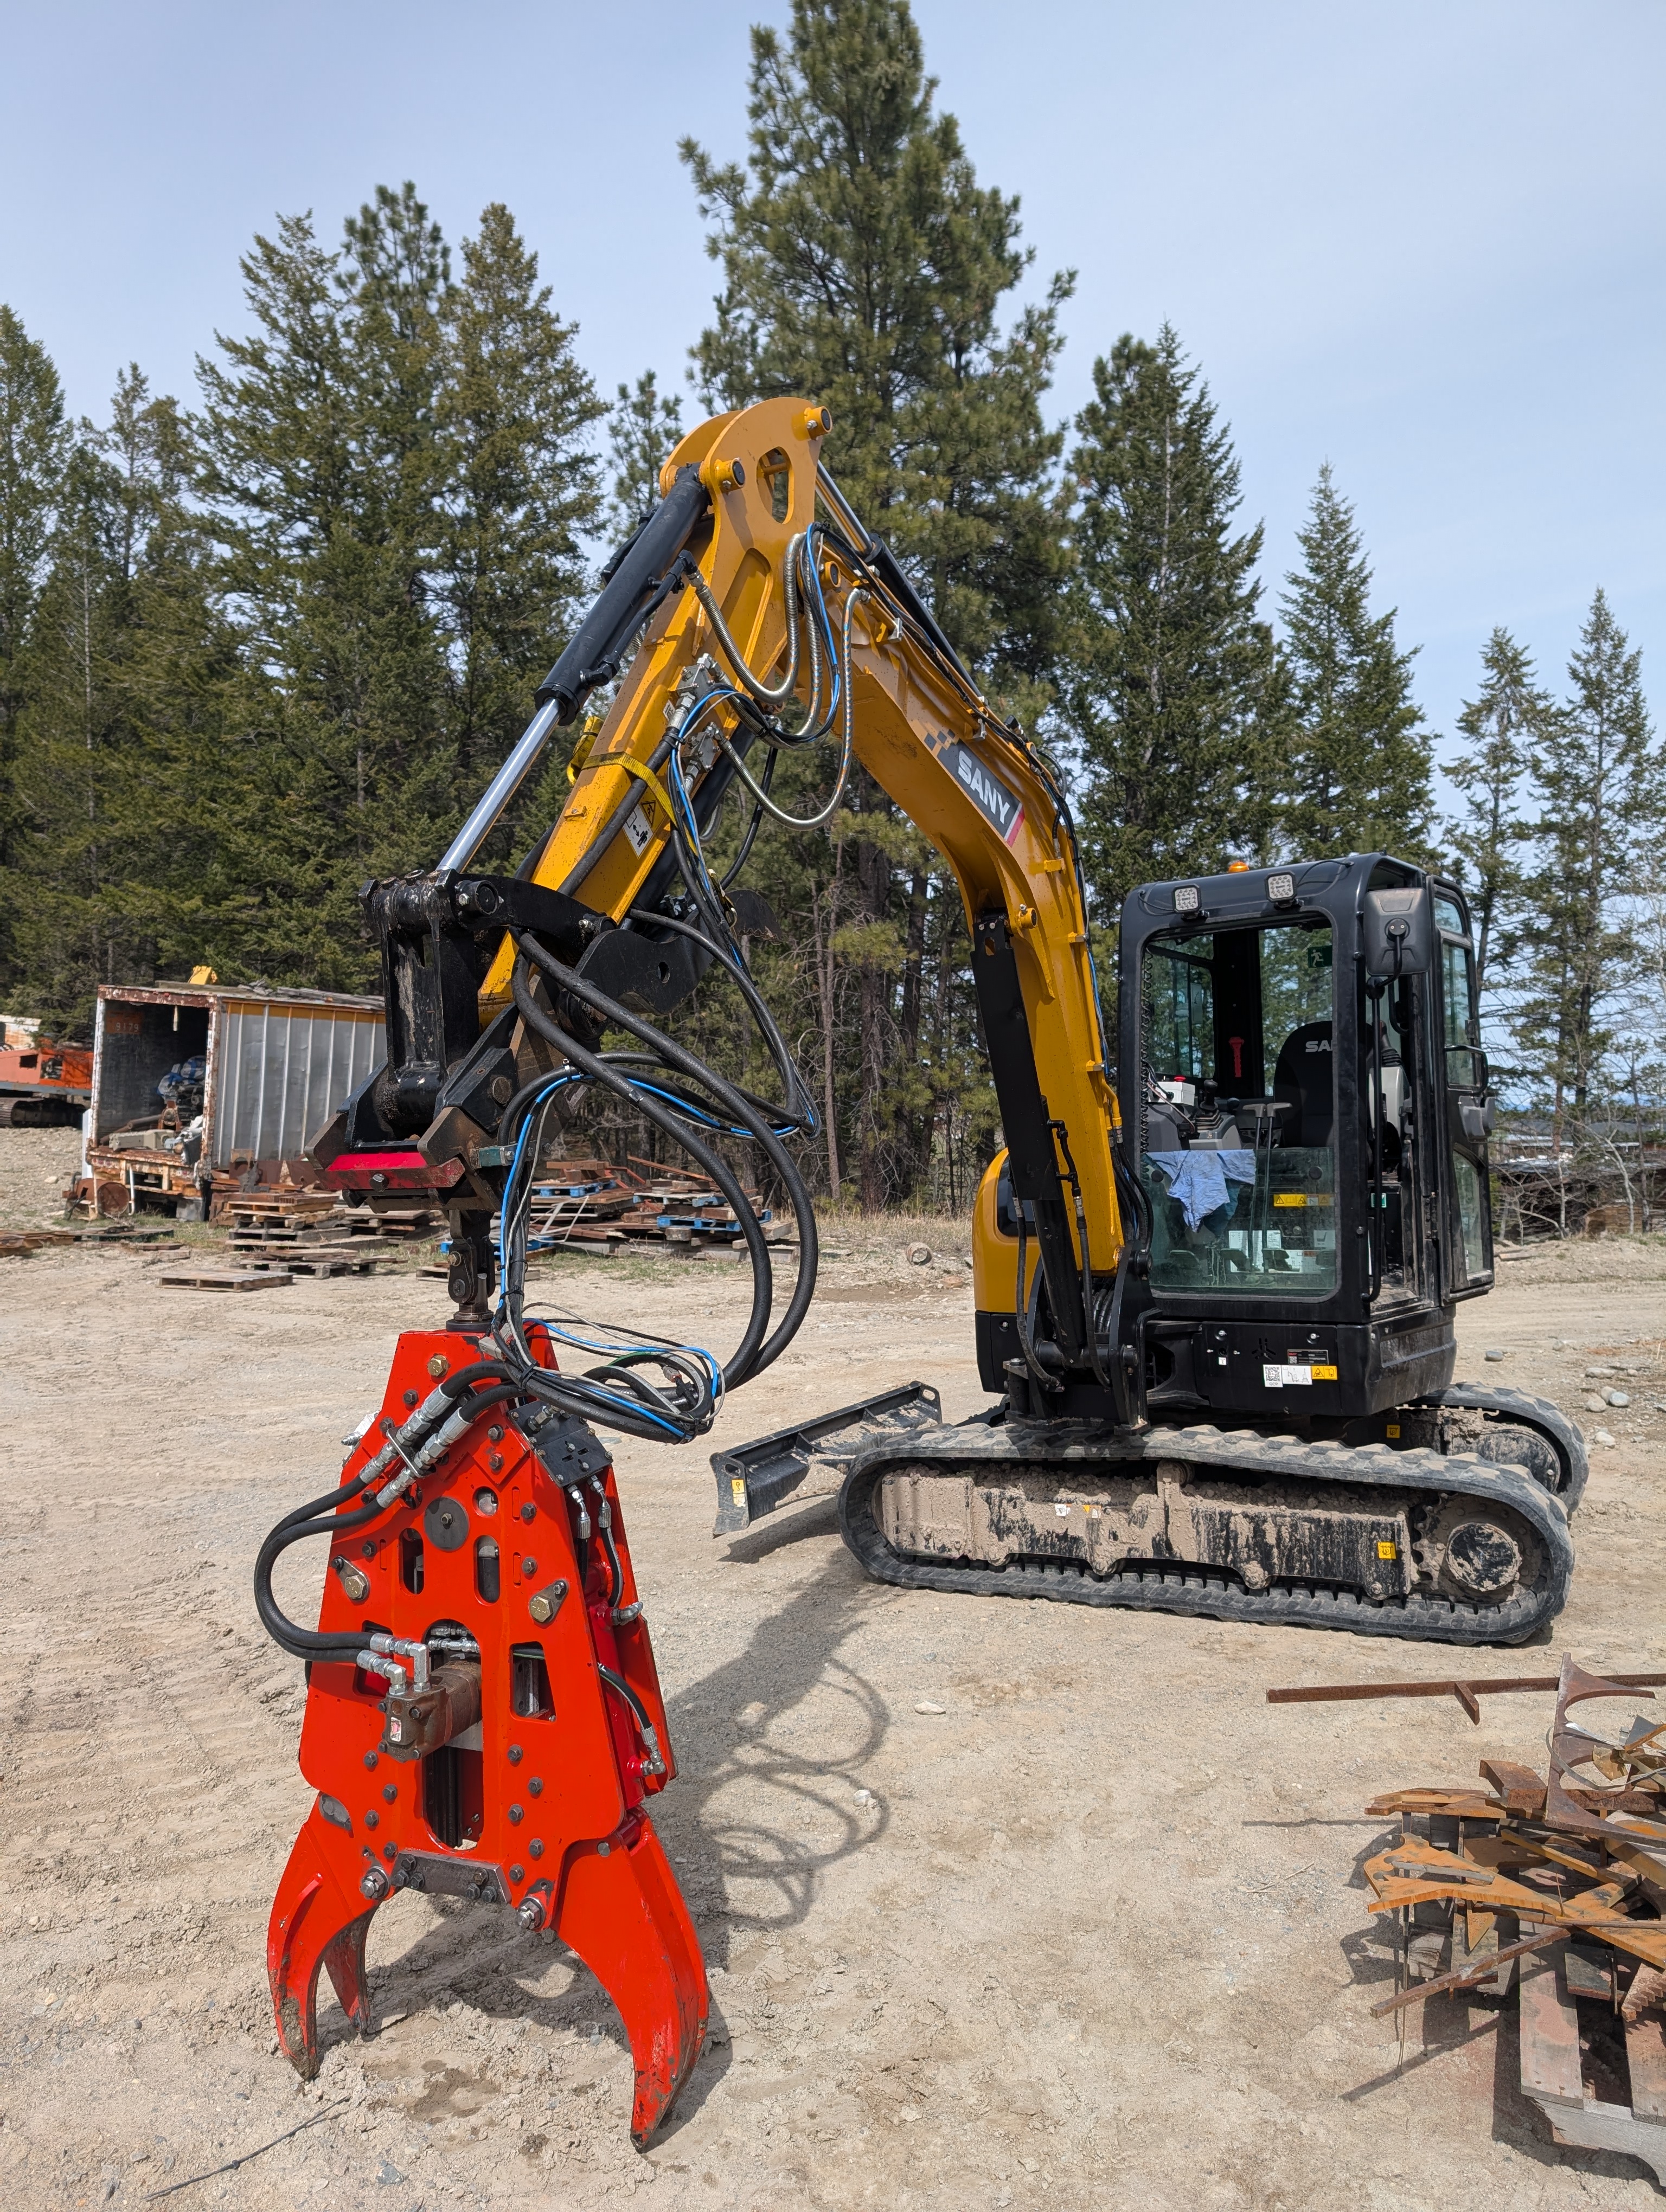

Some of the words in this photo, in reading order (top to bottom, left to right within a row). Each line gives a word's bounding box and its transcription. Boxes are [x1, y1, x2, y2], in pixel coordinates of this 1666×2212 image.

[958, 750, 1010, 825] SANY
[116, 1022, 139, 1032] 9179
[1305, 1039, 1333, 1052] SA
